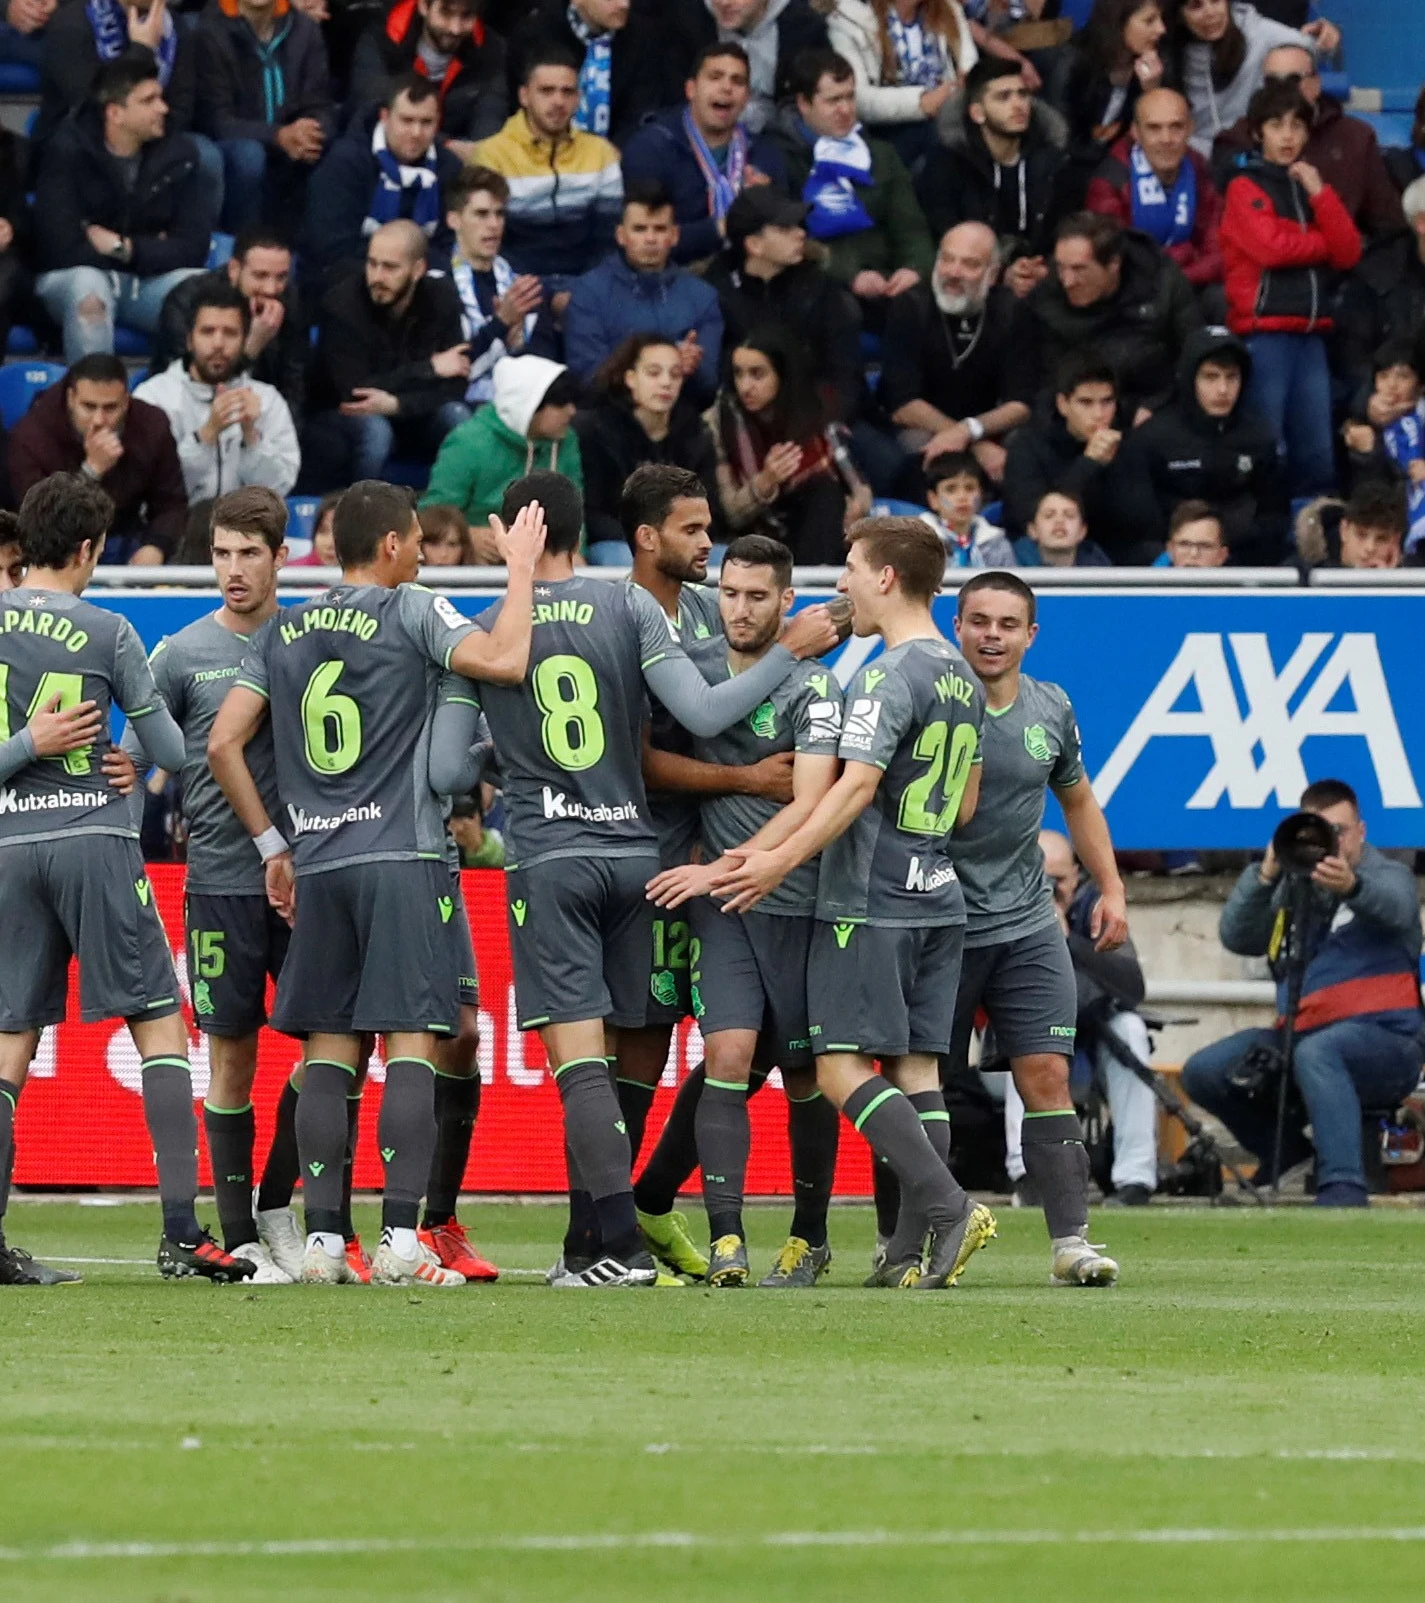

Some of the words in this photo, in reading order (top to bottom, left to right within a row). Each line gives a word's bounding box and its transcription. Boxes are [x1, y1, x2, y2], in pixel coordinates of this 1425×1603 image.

[532, 600, 594, 625] ERINO
[301, 660, 362, 774] 6
[532, 655, 606, 772] 8
[1089, 632, 1424, 809] AXA
[896, 721, 978, 837] 29
[191, 929, 225, 978] 15
[652, 919, 689, 968] 12
